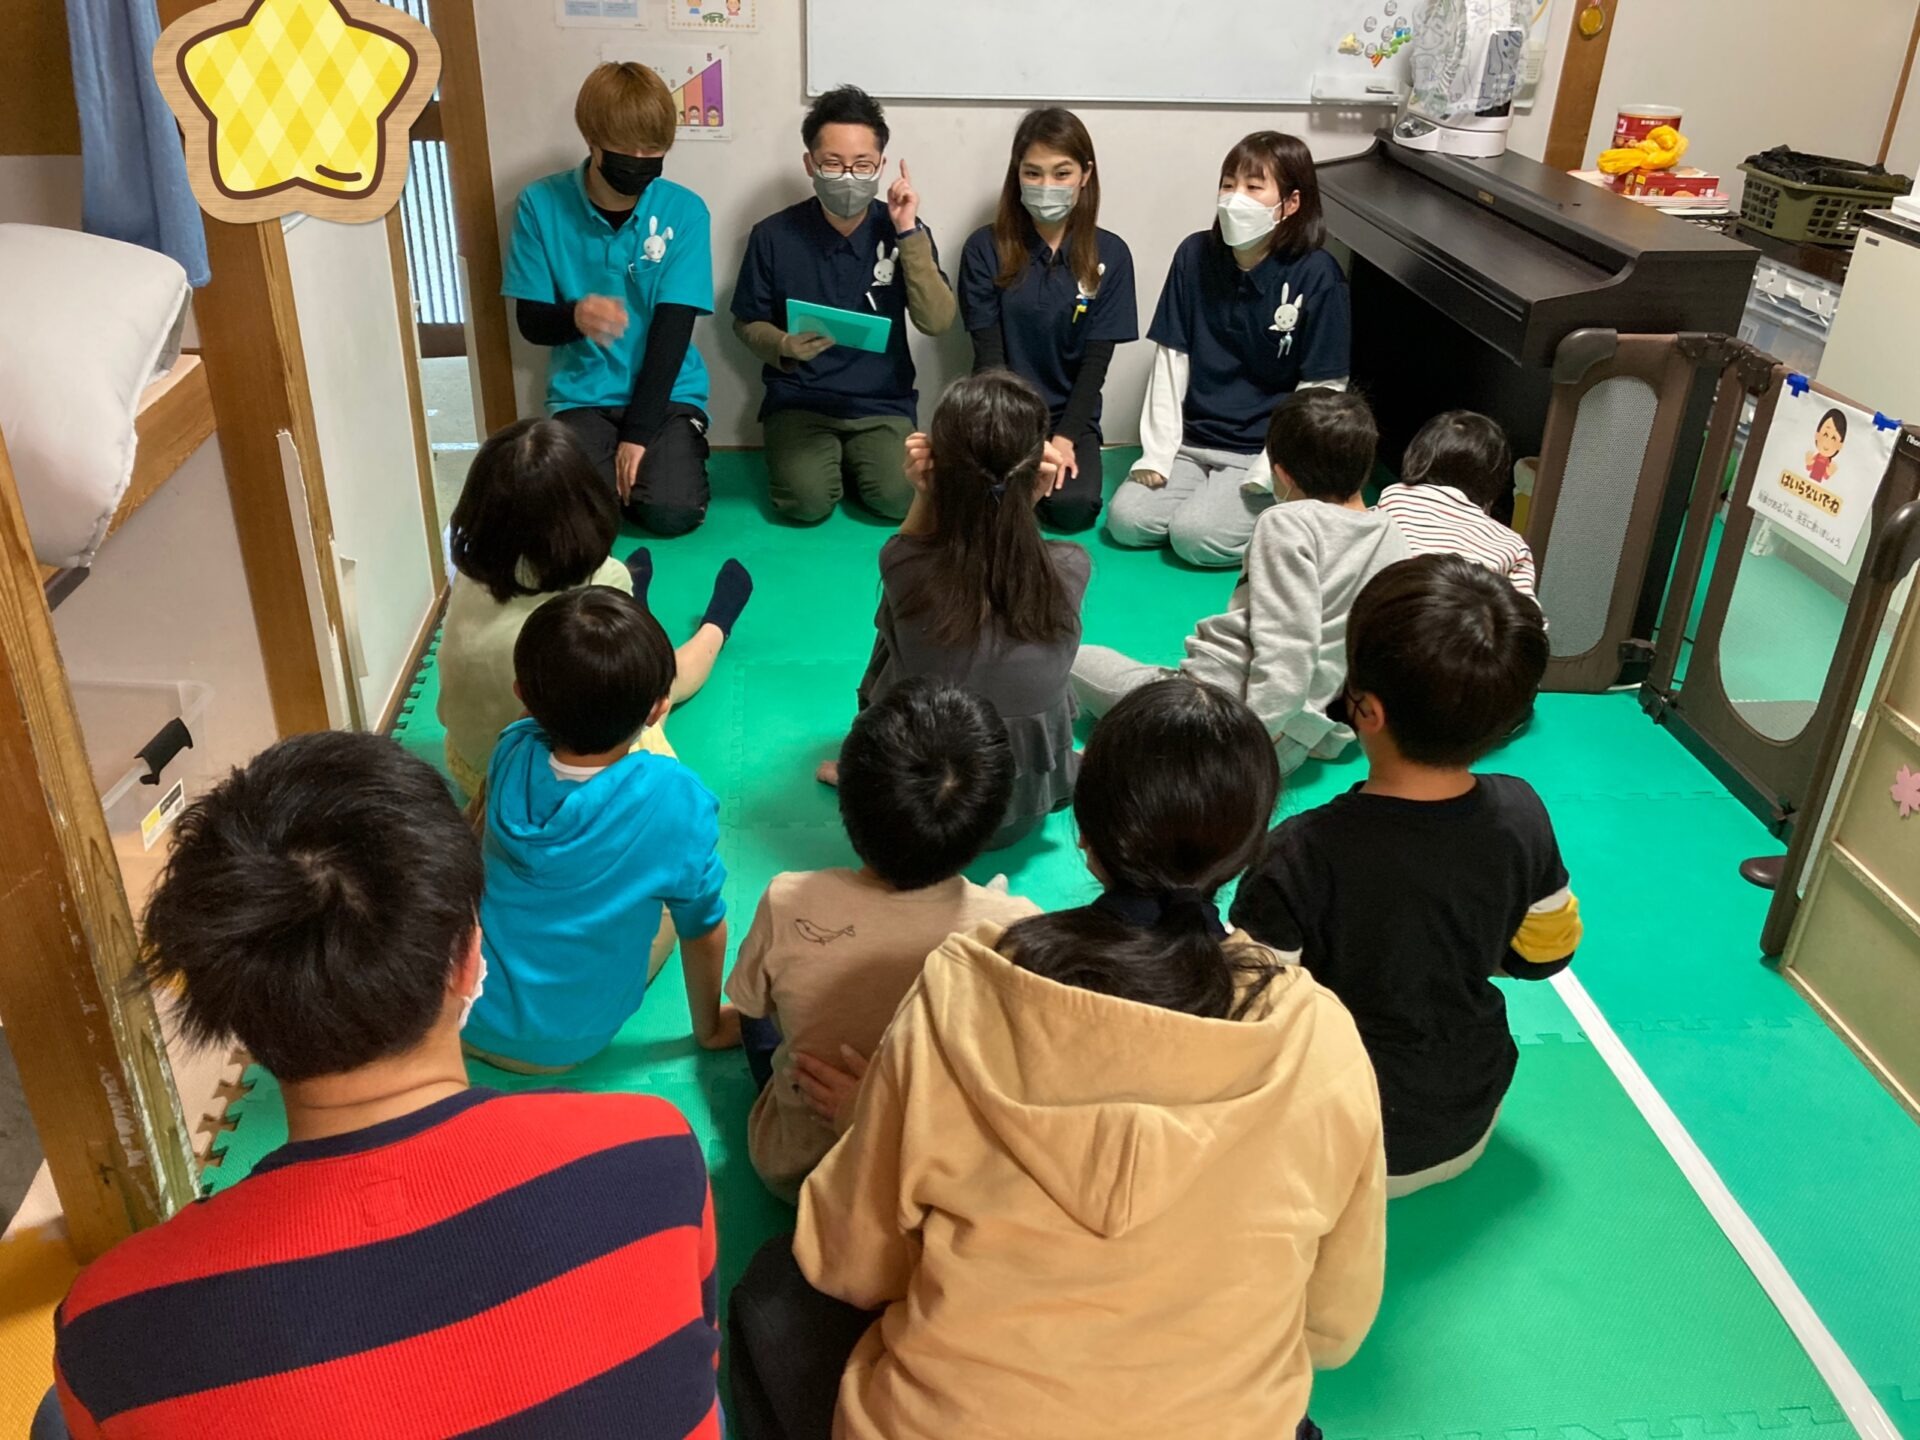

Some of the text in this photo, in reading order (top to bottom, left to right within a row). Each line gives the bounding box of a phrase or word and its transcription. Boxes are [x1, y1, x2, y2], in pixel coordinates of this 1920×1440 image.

[706, 52, 713, 62] 5
[1781, 473, 1840, 514] はいらないでね
